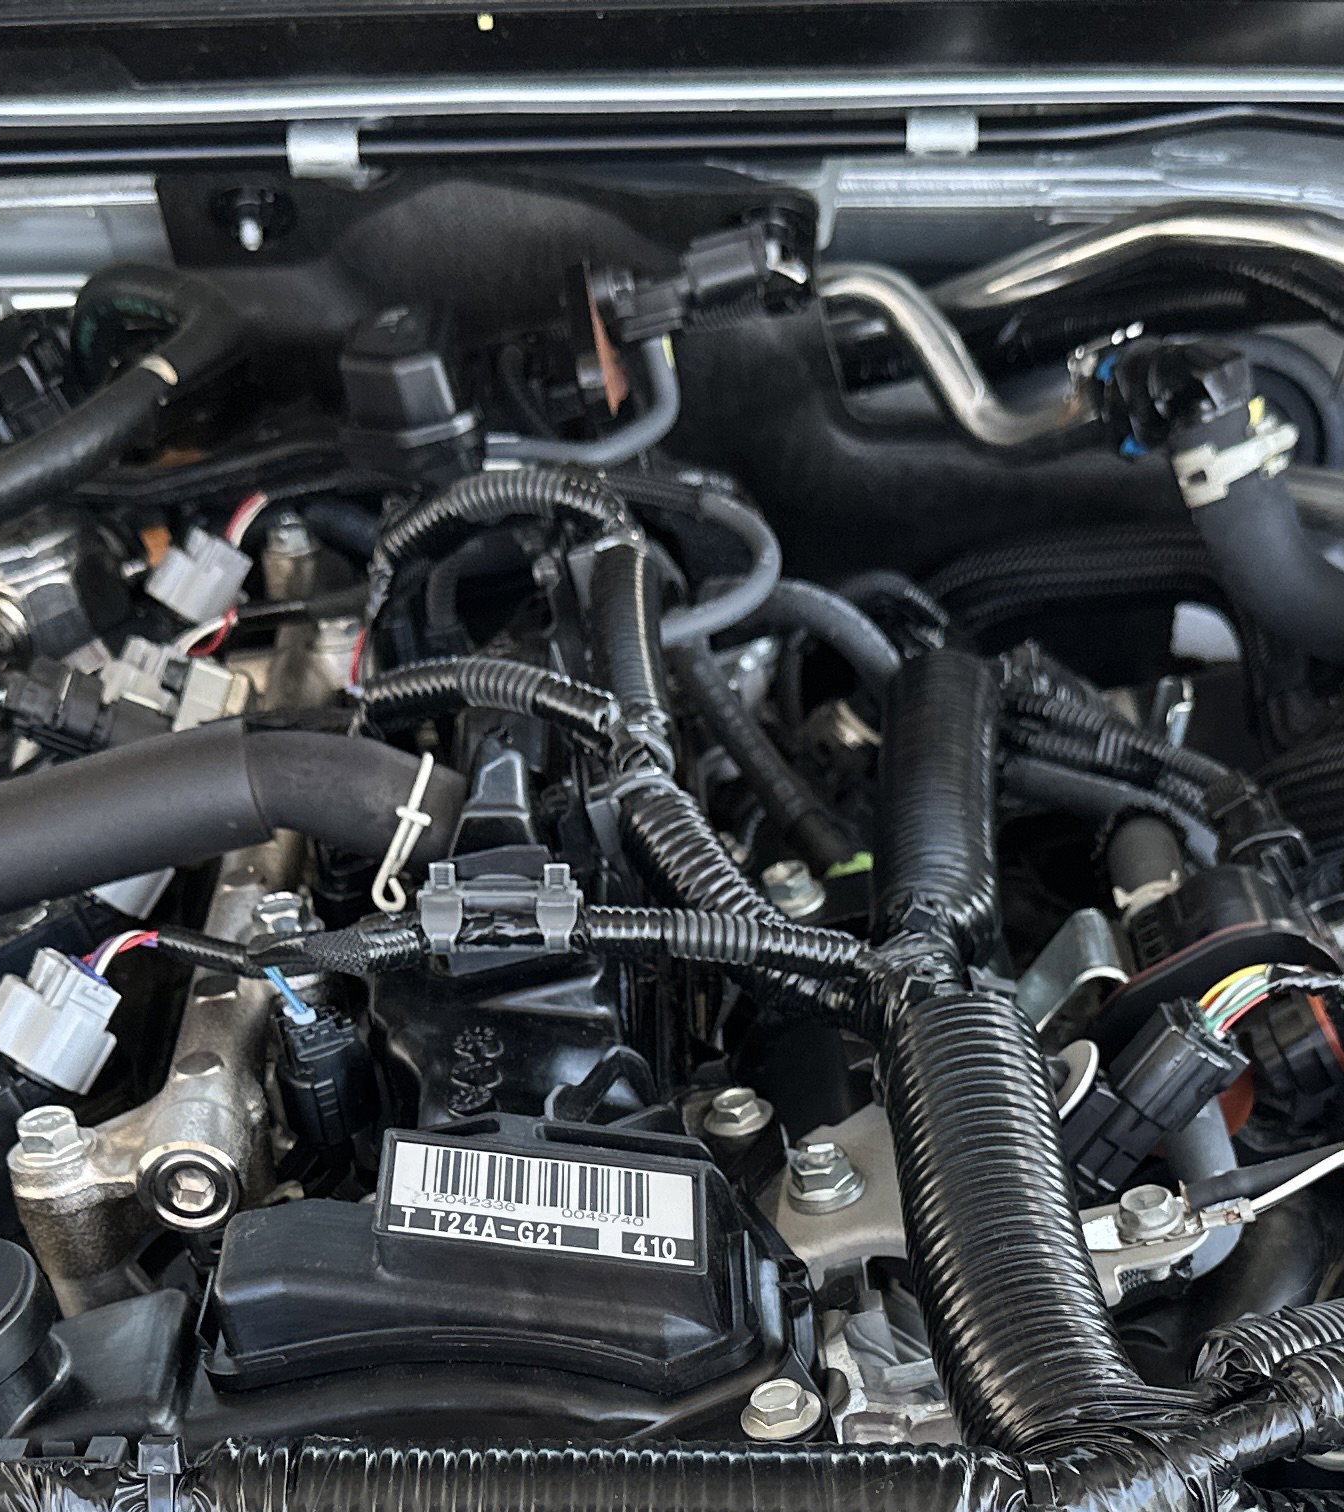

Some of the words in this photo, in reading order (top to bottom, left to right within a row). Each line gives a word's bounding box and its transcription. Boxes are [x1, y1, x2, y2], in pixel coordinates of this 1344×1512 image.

[423, 1192, 516, 1212] 12042336
[561, 1208, 644, 1227] 0045740
[401, 1207, 416, 1228] T
[431, 1210, 563, 1246] T24A-G21
[633, 1235, 677, 1260] 410
